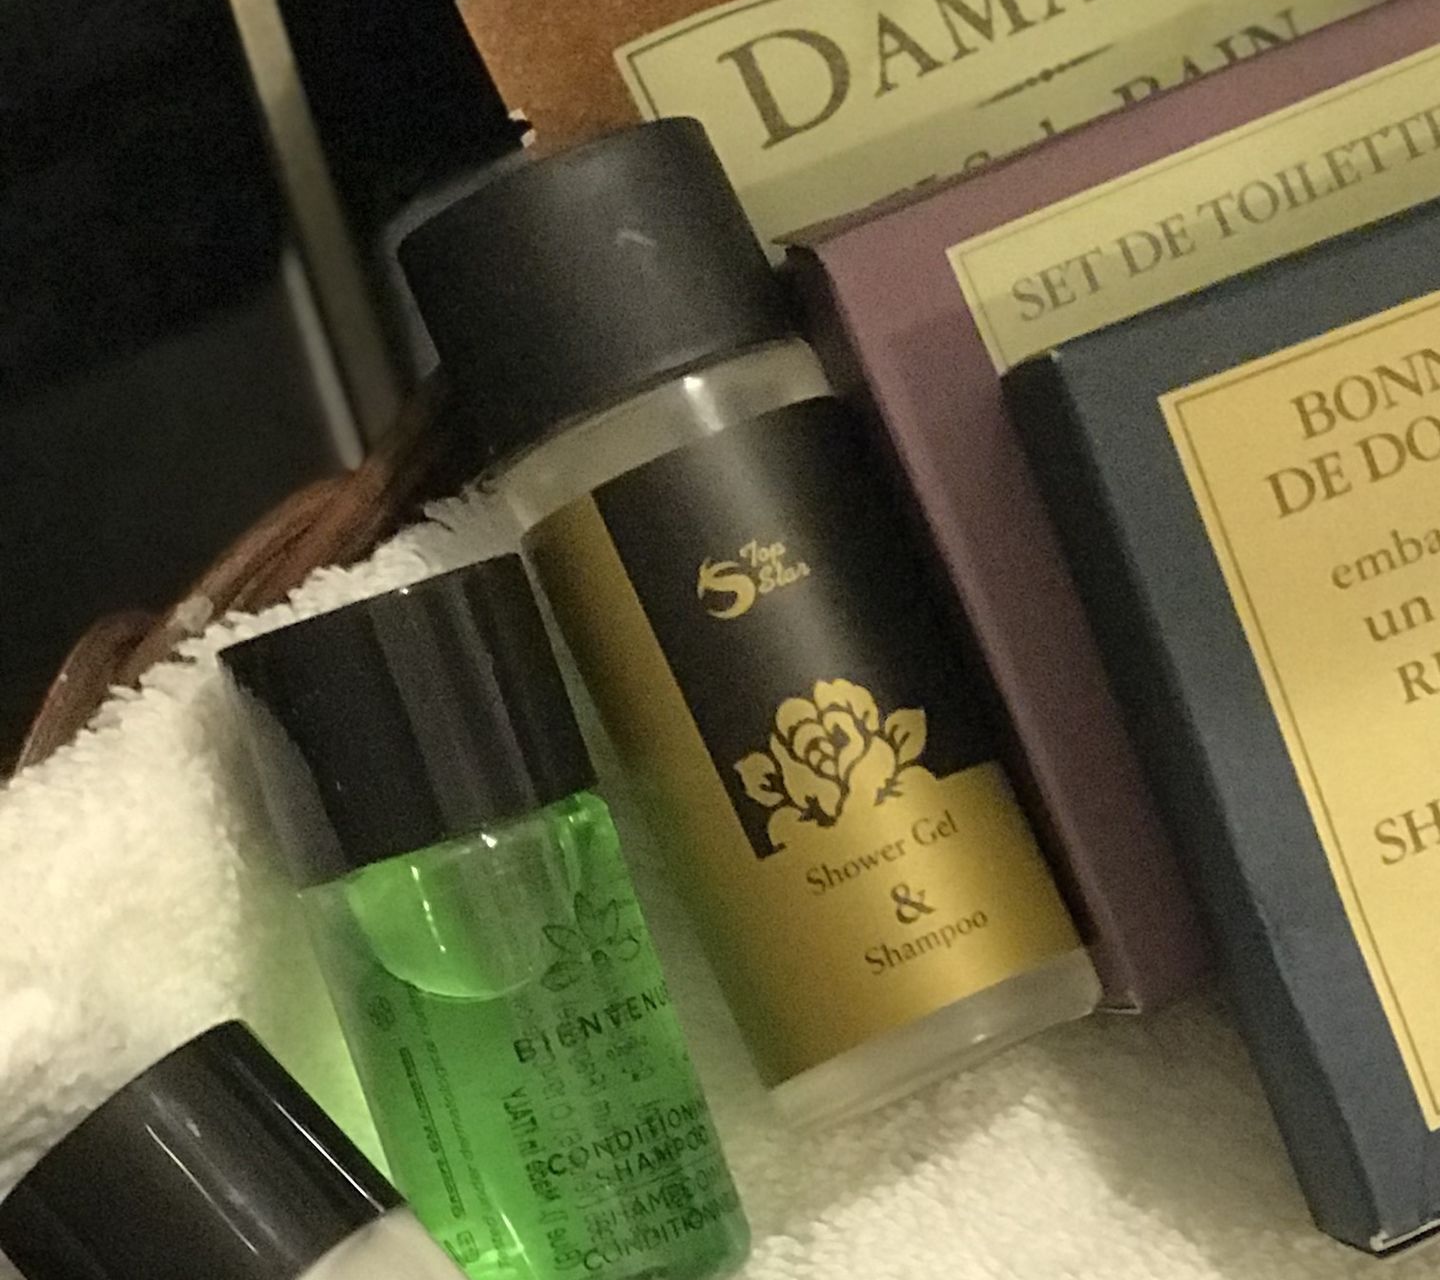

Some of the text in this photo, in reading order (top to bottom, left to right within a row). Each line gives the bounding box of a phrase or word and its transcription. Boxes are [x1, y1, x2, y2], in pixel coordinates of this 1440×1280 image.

[1011, 245, 1103, 322] SET
[1116, 212, 1197, 279] DE
[1263, 451, 1353, 519] DE
[739, 539, 786, 568] Top
[759, 562, 811, 594] Star
[1363, 594, 1436, 643] un
[806, 808, 959, 897] Shower Gel
[890, 882, 937, 925] &
[864, 909, 990, 976] Shampoo
